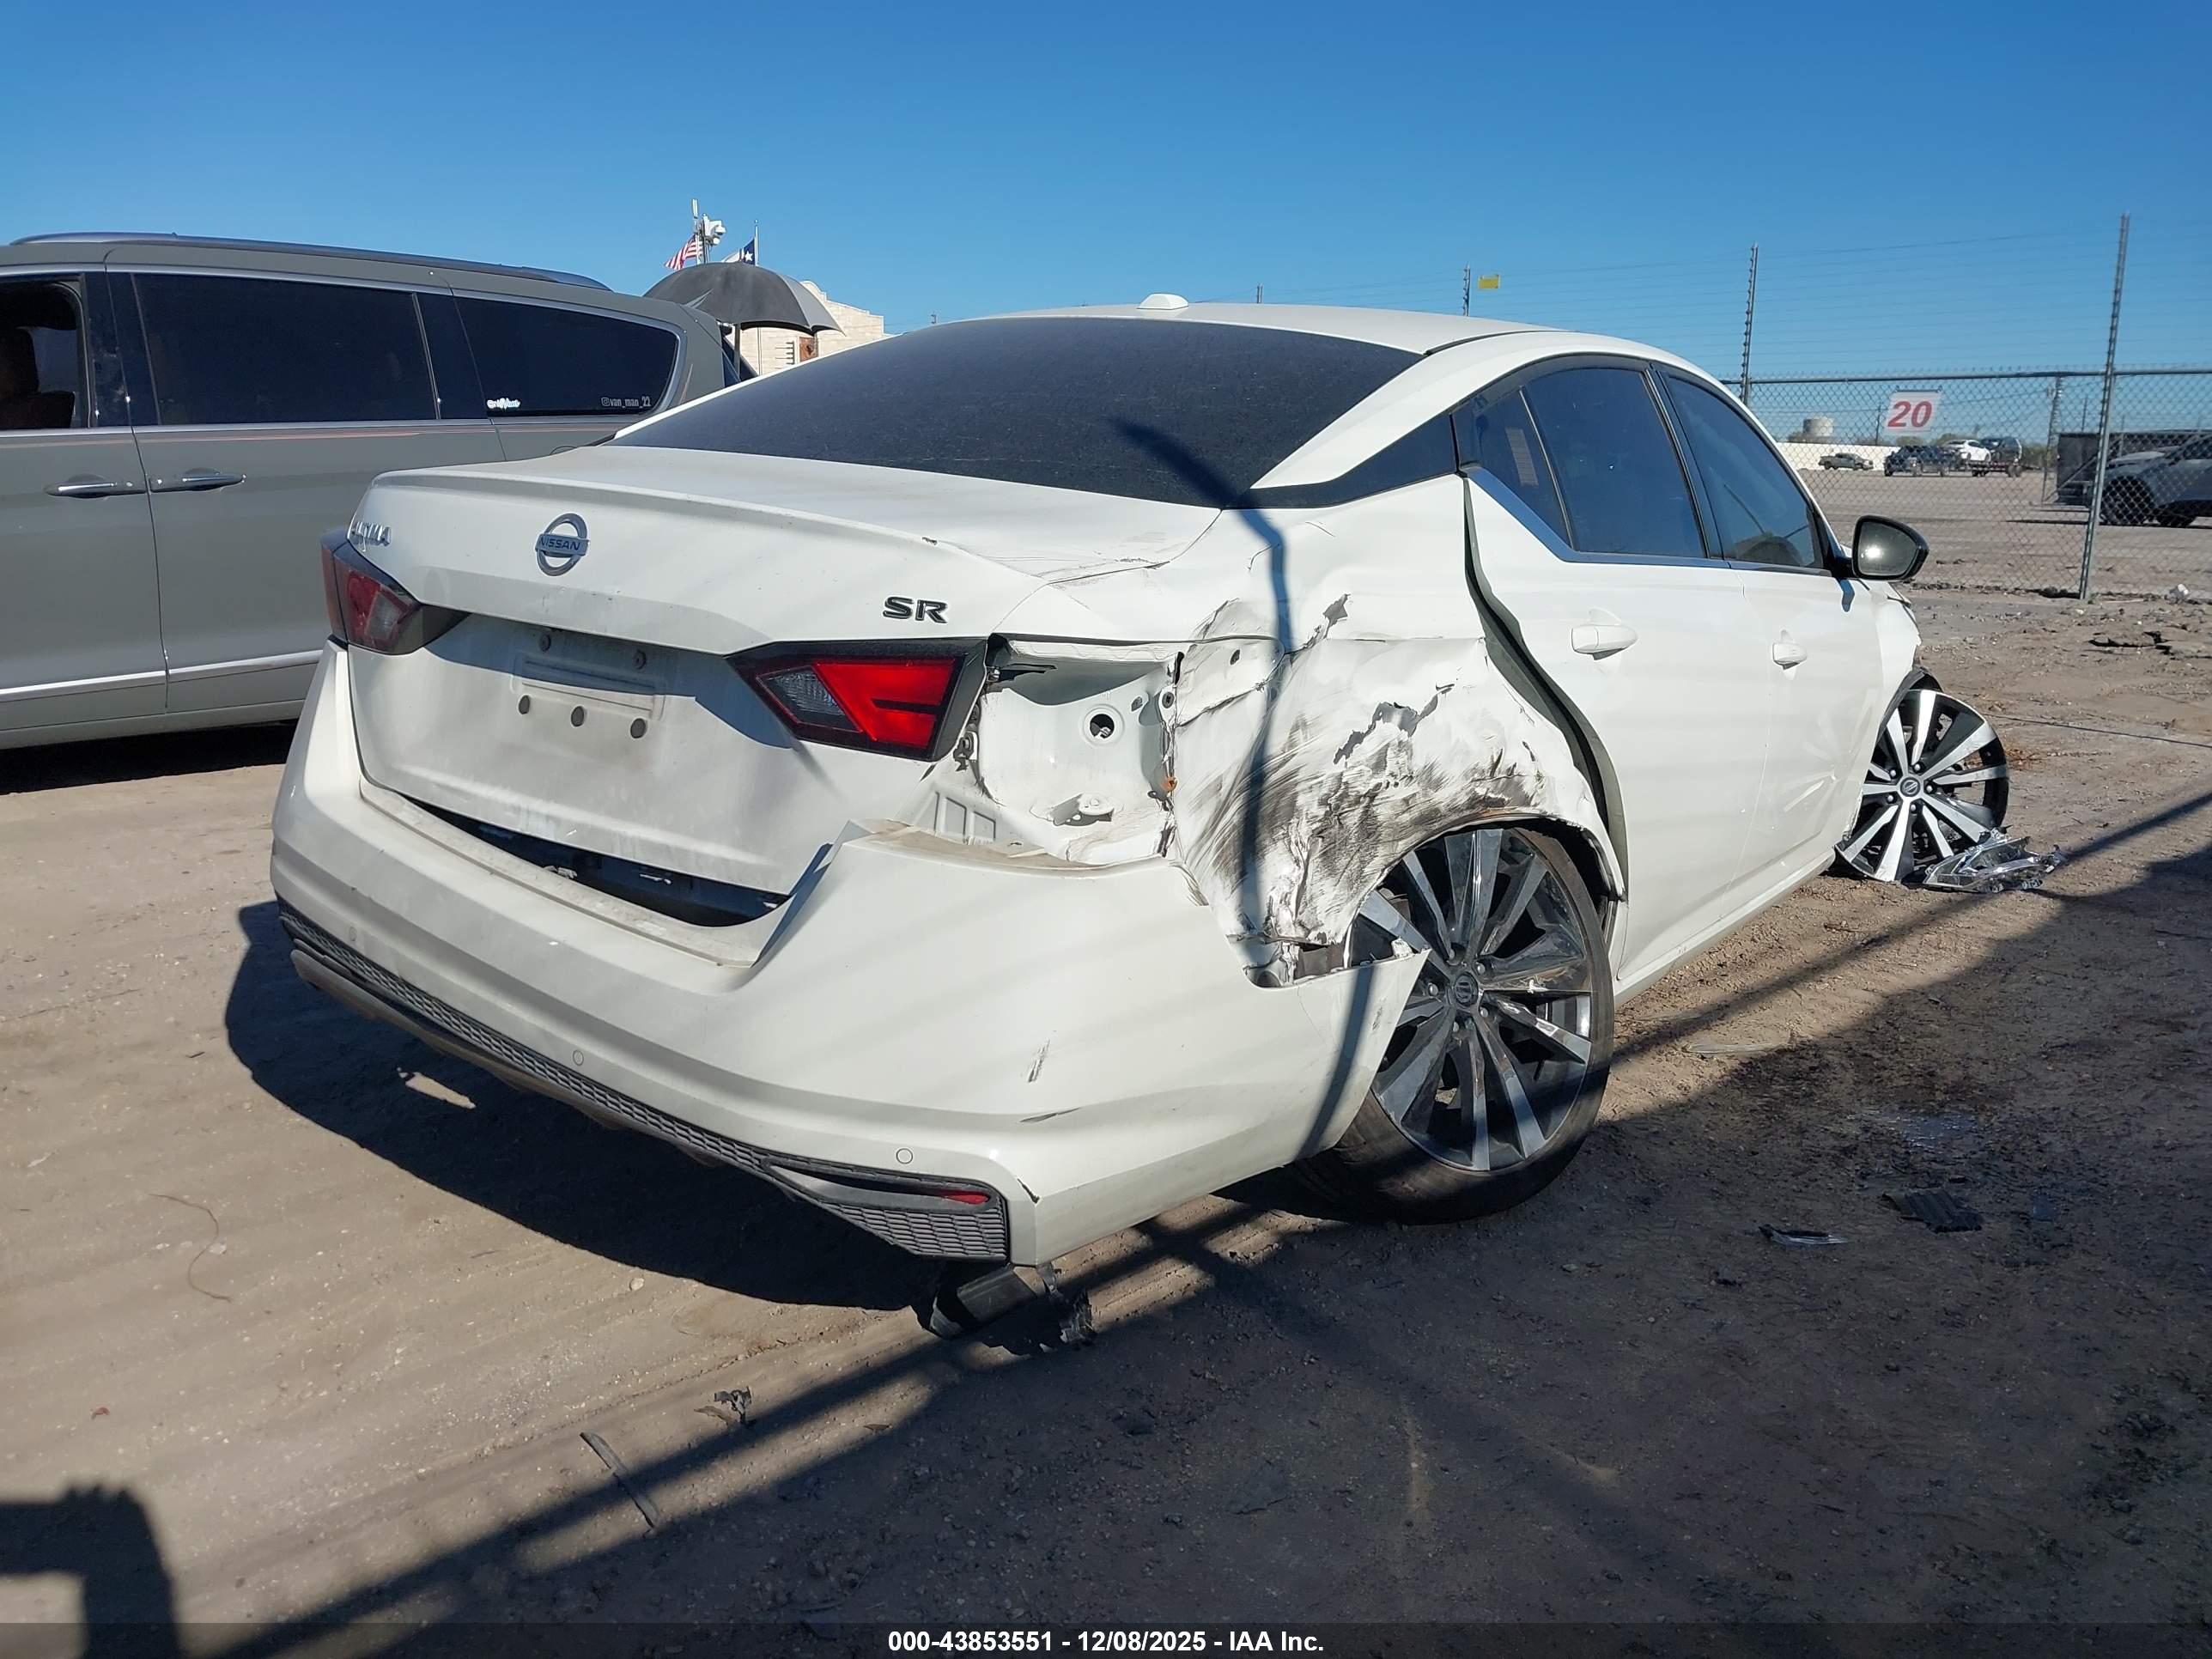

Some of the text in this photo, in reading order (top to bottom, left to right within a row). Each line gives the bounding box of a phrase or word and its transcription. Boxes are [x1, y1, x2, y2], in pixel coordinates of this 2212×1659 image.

[1887, 400, 1933, 428] 20
[540, 536, 581, 551] NISSAN
[882, 595, 948, 624] SR
